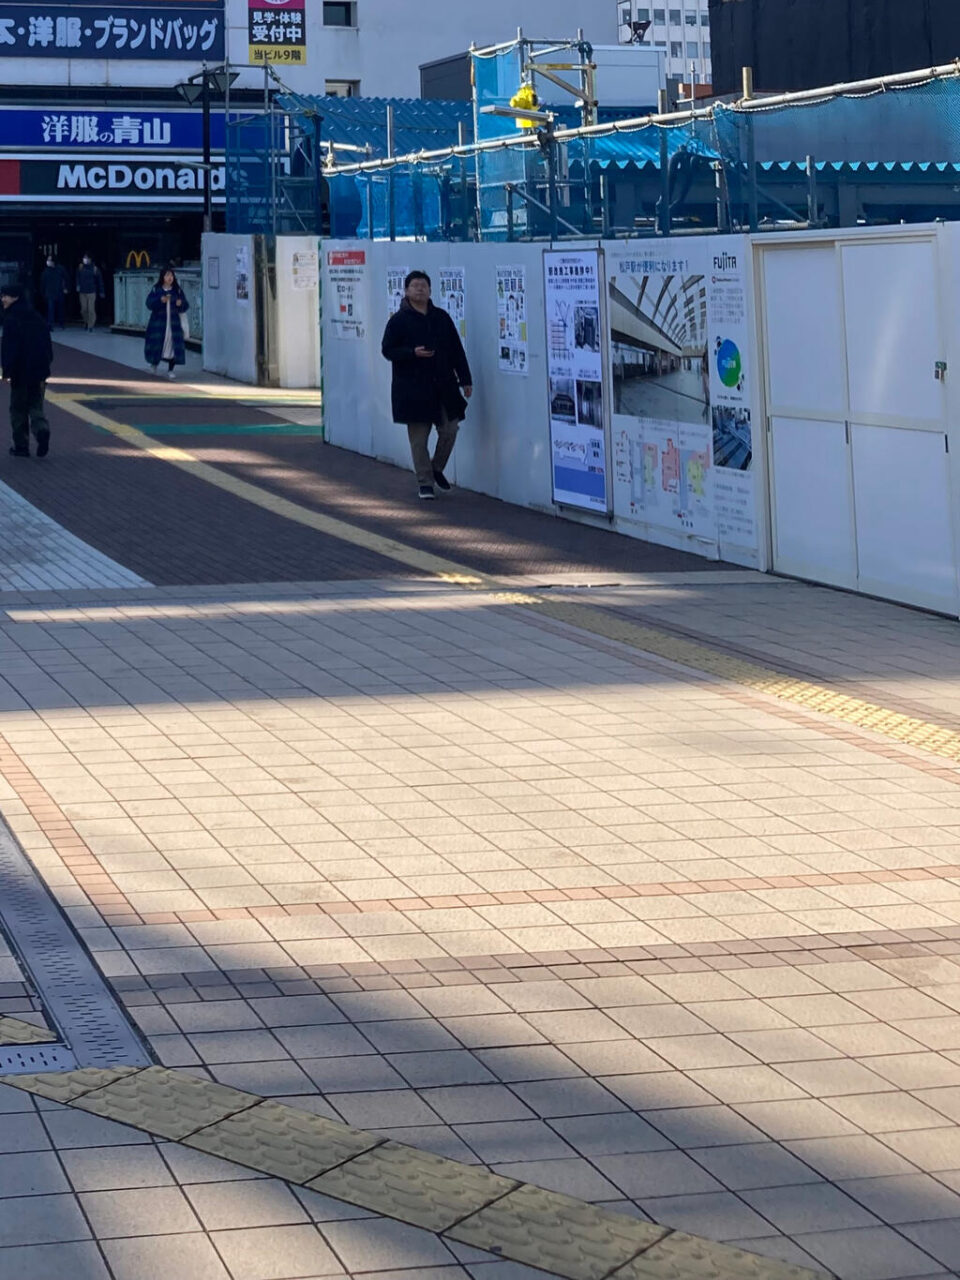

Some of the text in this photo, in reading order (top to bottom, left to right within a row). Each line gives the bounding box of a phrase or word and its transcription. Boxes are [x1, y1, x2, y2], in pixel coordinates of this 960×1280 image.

[252, 25, 302, 42] 受付中
[254, 49, 301, 61] 当ビル9階
[41, 115, 171, 145] 洋服の青山
